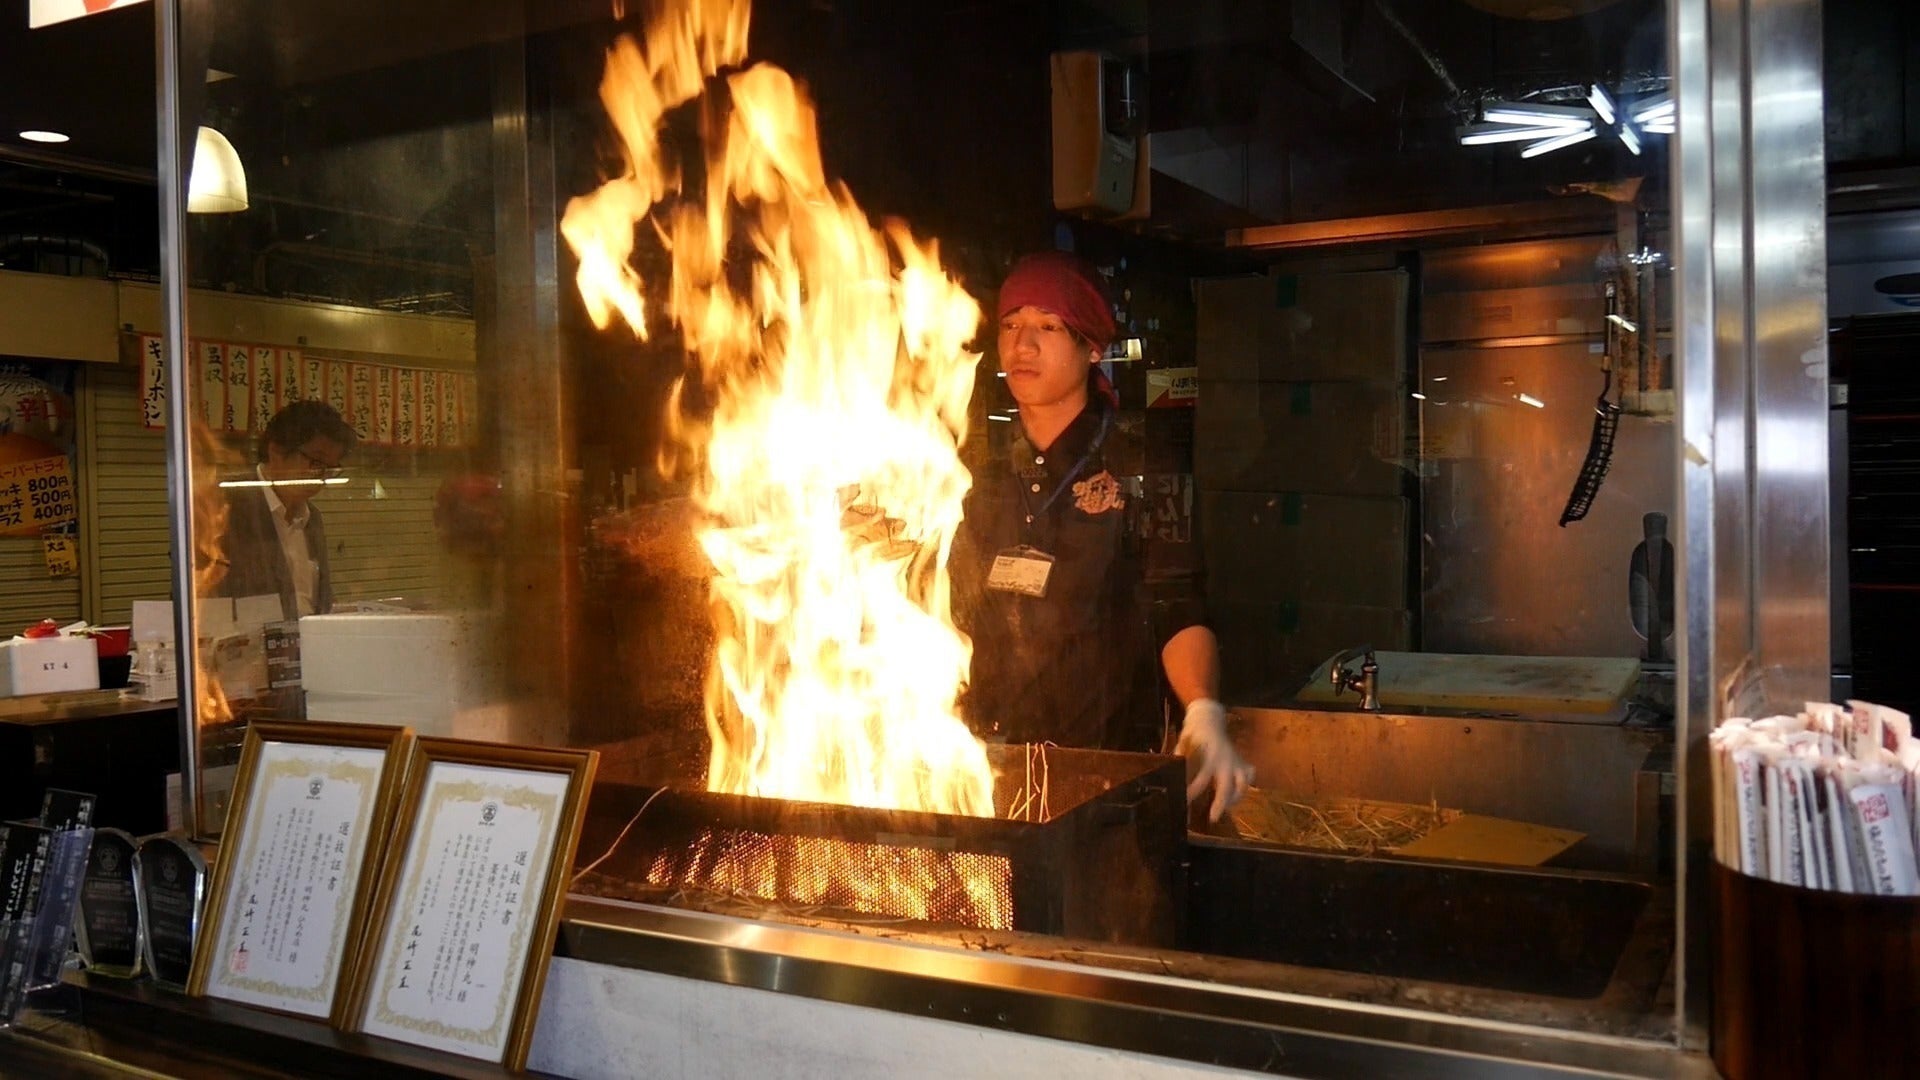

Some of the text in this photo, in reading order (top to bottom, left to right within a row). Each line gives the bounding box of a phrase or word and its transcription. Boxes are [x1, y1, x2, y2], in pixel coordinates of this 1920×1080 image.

[0, 459, 65, 479] ーパードライ
[28, 476, 68, 492] 800円
[31, 490, 71, 507] 500円
[33, 504, 73, 520] 400円
[328, 821, 350, 891] 選抜証書
[502, 850, 528, 925] 選抜証書
